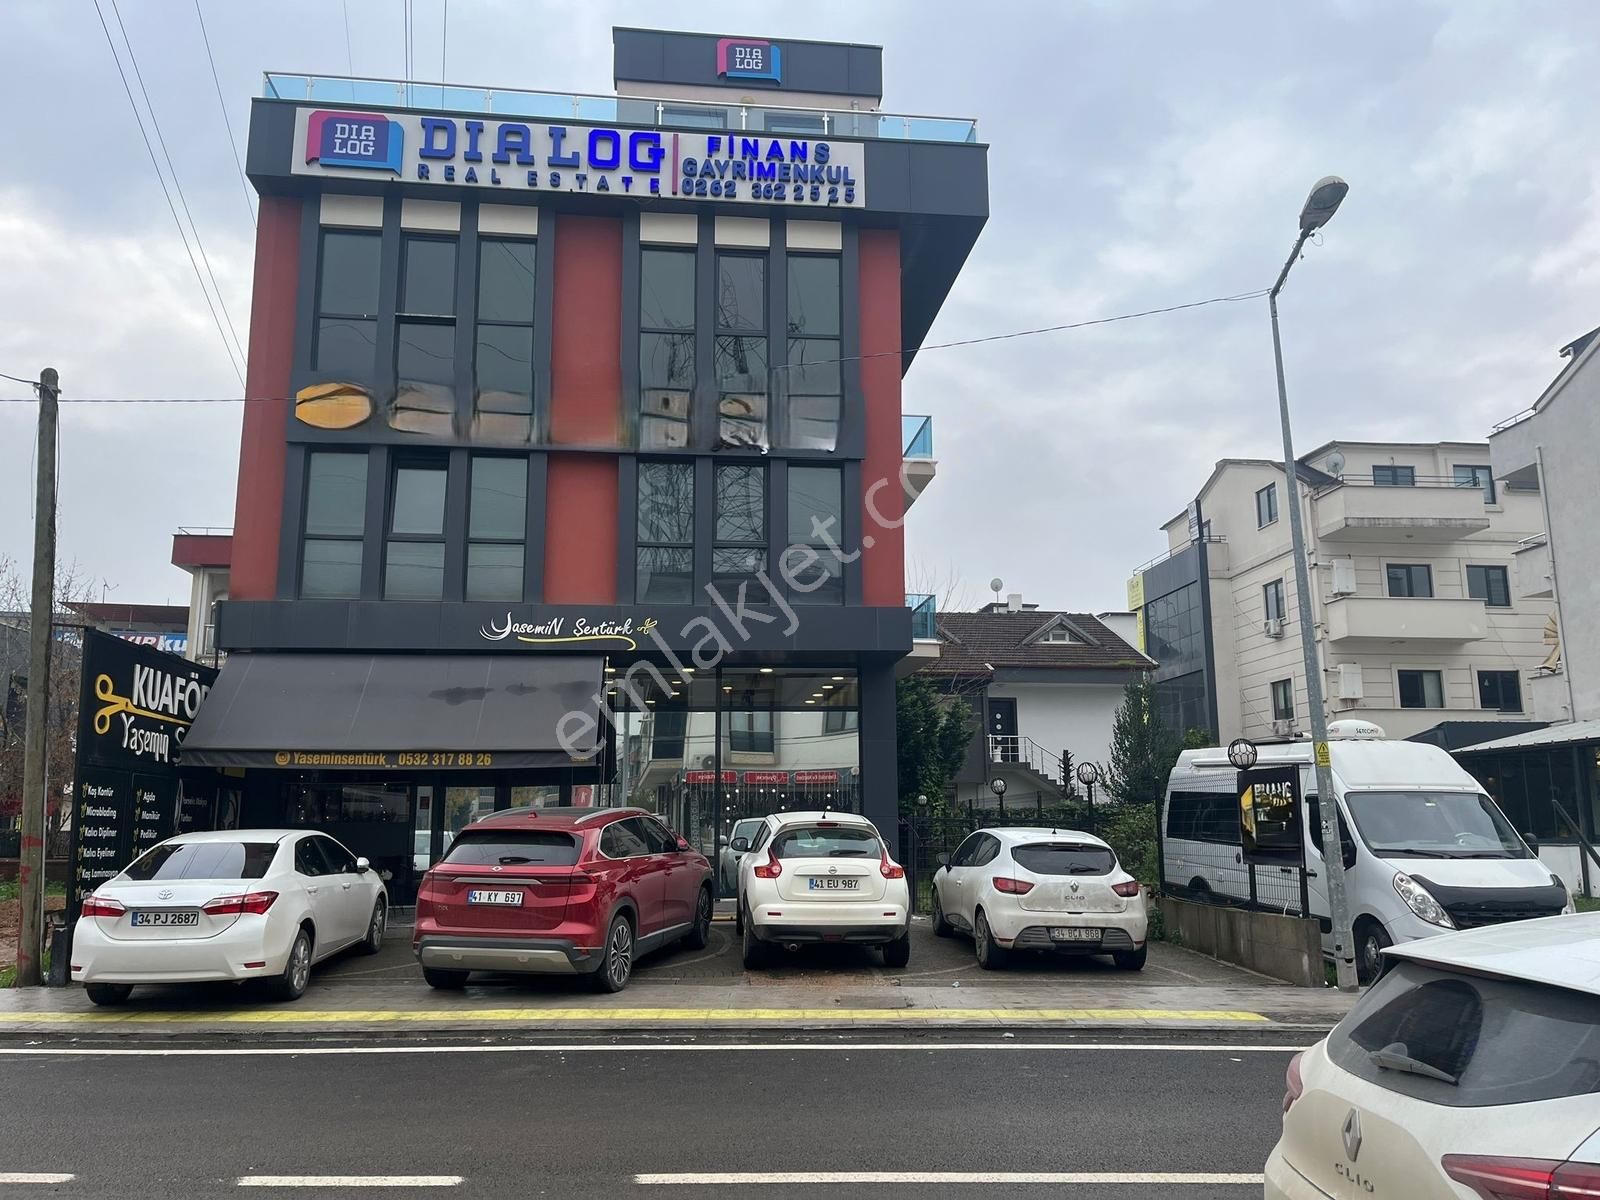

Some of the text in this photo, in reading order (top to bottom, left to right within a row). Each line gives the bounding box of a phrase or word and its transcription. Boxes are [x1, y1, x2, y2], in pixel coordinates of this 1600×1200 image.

[735, 47, 763, 59] DIA
[735, 58, 763, 70] LOG
[334, 123, 376, 141] DIA
[333, 139, 375, 156] LOG
[419, 117, 666, 174] DIALOG
[417, 163, 661, 194] REAL ESTATE
[682, 177, 737, 199] 0262
[751, 182, 787, 201] 362
[573, 618, 634, 639] Şentürk
[398, 753, 429, 767] 0532
[432, 753, 453, 767] 317
[458, 753, 473, 767] 88
[476, 753, 492, 767] 26
[813, 879, 858, 889] 41 EU 987
[471, 891, 522, 904] 41 KY 697
[139, 913, 197, 924] 34 PJ 2687
[1054, 928, 1065, 938] 34
[1335, 1162, 1375, 1193] CLIO
